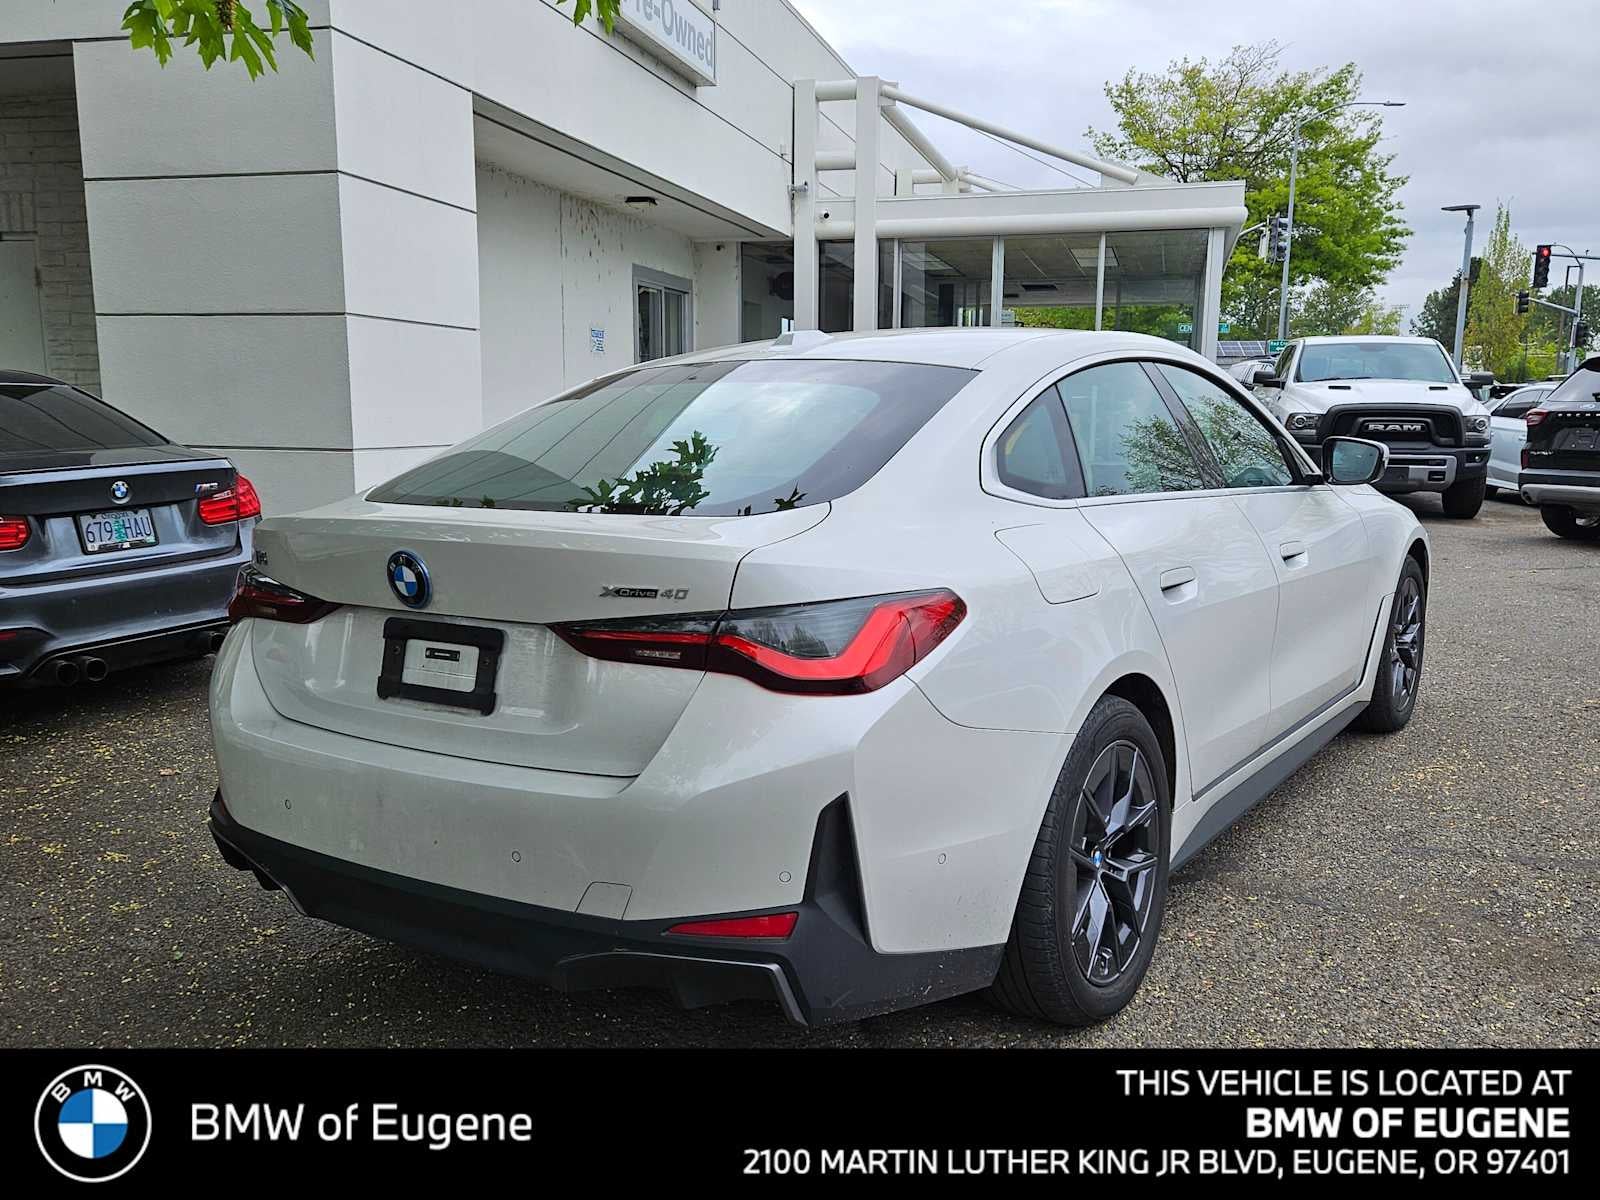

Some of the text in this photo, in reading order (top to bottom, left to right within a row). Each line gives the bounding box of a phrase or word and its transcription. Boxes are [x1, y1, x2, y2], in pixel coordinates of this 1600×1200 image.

[86, 516, 152, 543] 679 HAU
[660, 588, 689, 600] 40
